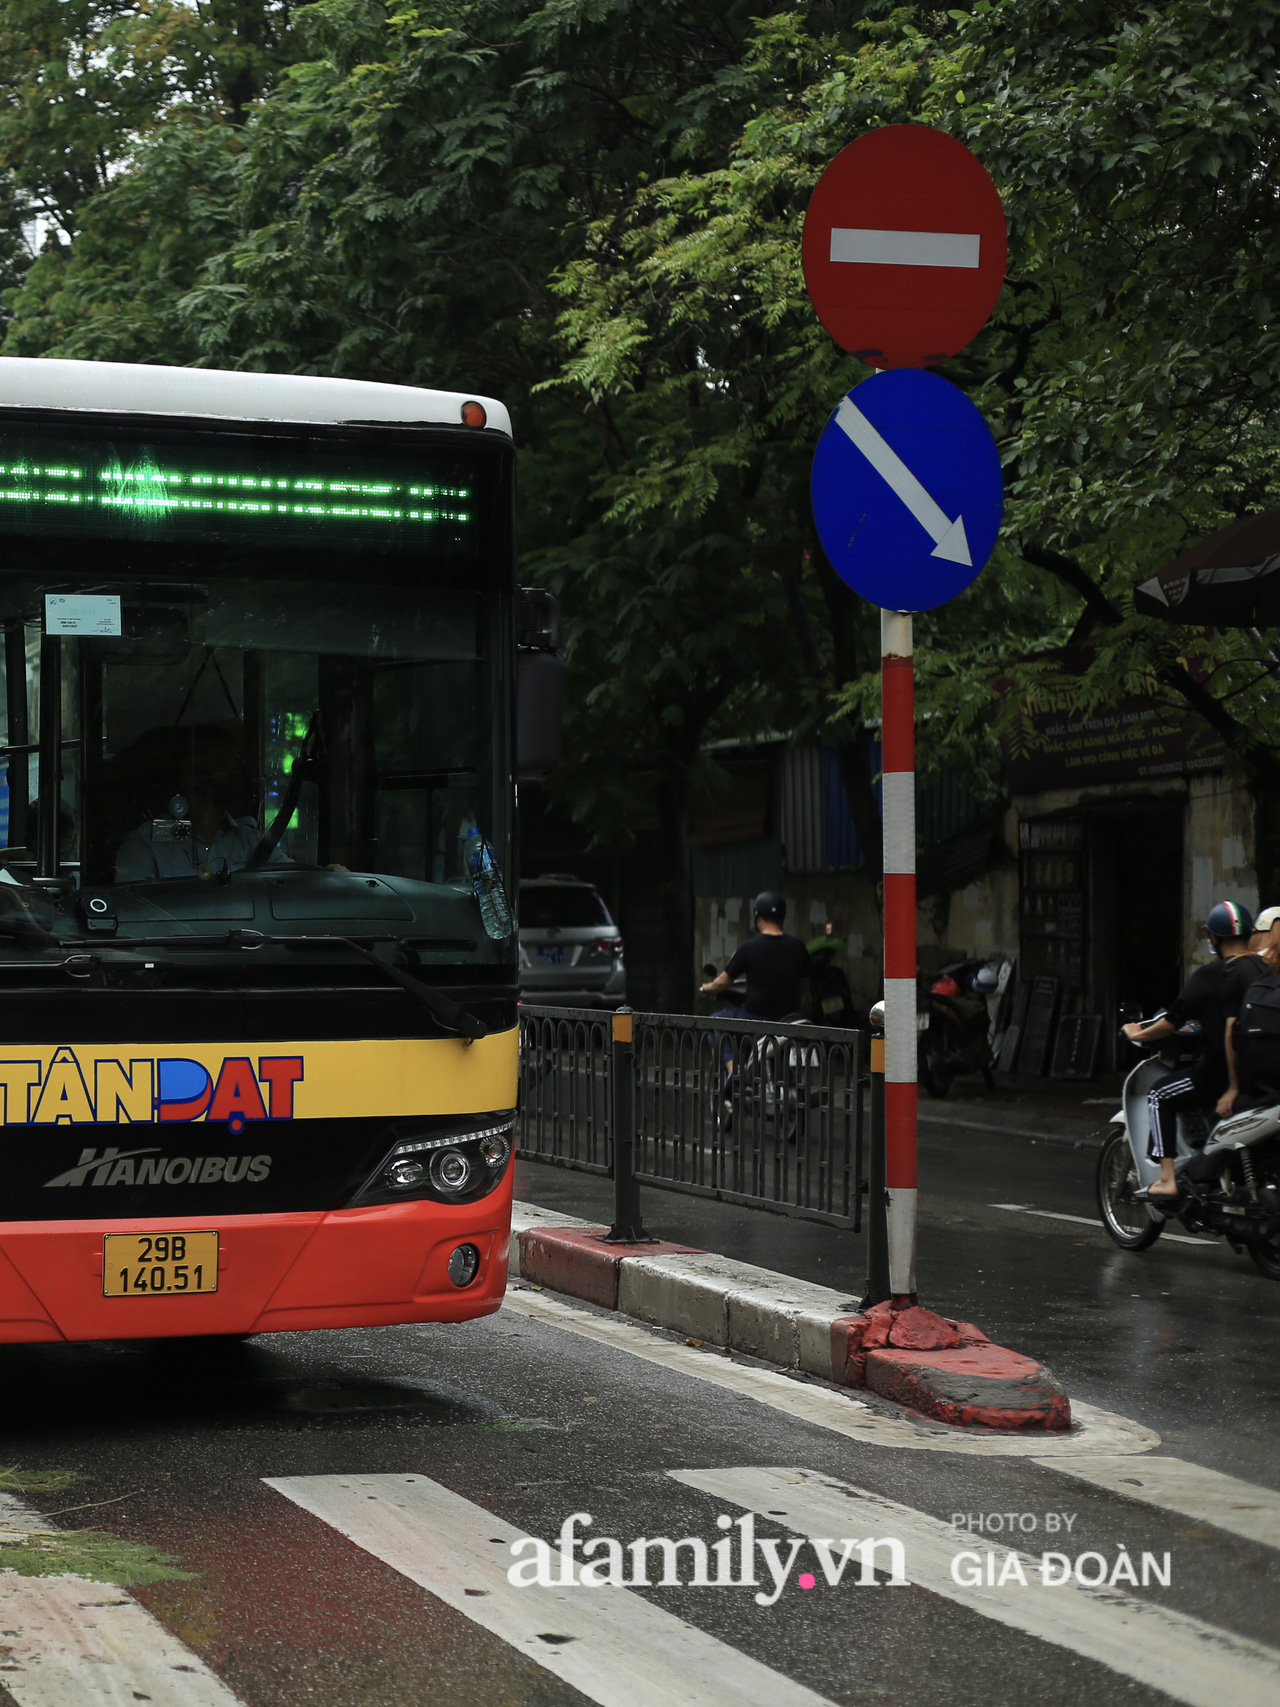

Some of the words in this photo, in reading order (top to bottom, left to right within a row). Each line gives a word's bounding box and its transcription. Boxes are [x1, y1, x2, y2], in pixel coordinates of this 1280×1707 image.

[41, 1147, 272, 1188] HANOIBUS
[138, 1236, 186, 1262] 29B
[120, 1265, 203, 1292] 140.51
